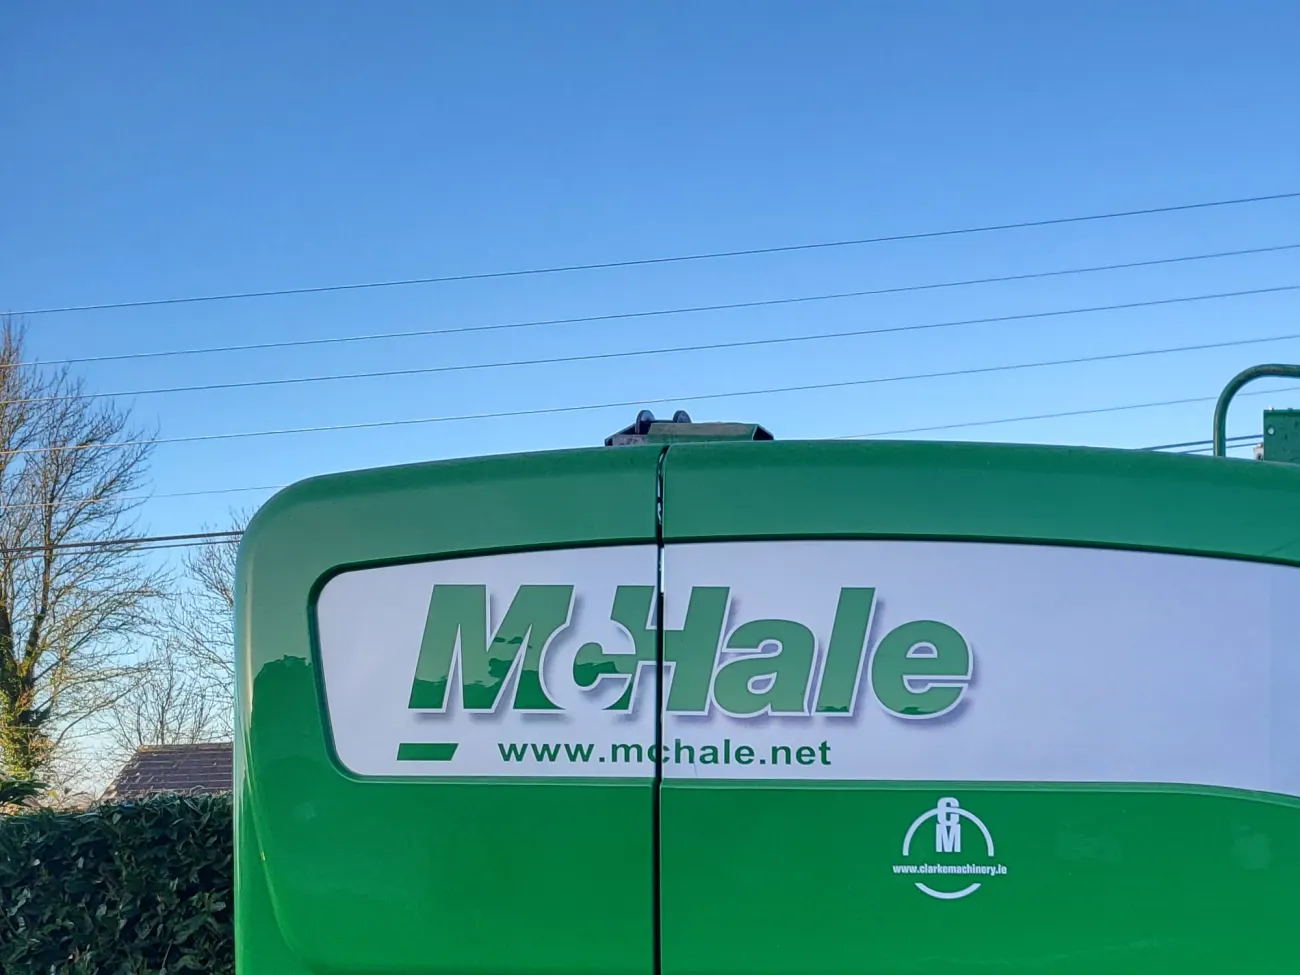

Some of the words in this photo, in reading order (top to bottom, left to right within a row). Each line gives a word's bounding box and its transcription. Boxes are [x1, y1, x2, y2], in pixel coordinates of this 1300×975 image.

[407, 583, 973, 718] McHale
[498, 738, 832, 766] www.mchale.net
[892, 863, 1007, 876] www.clarkemachinery.ie
